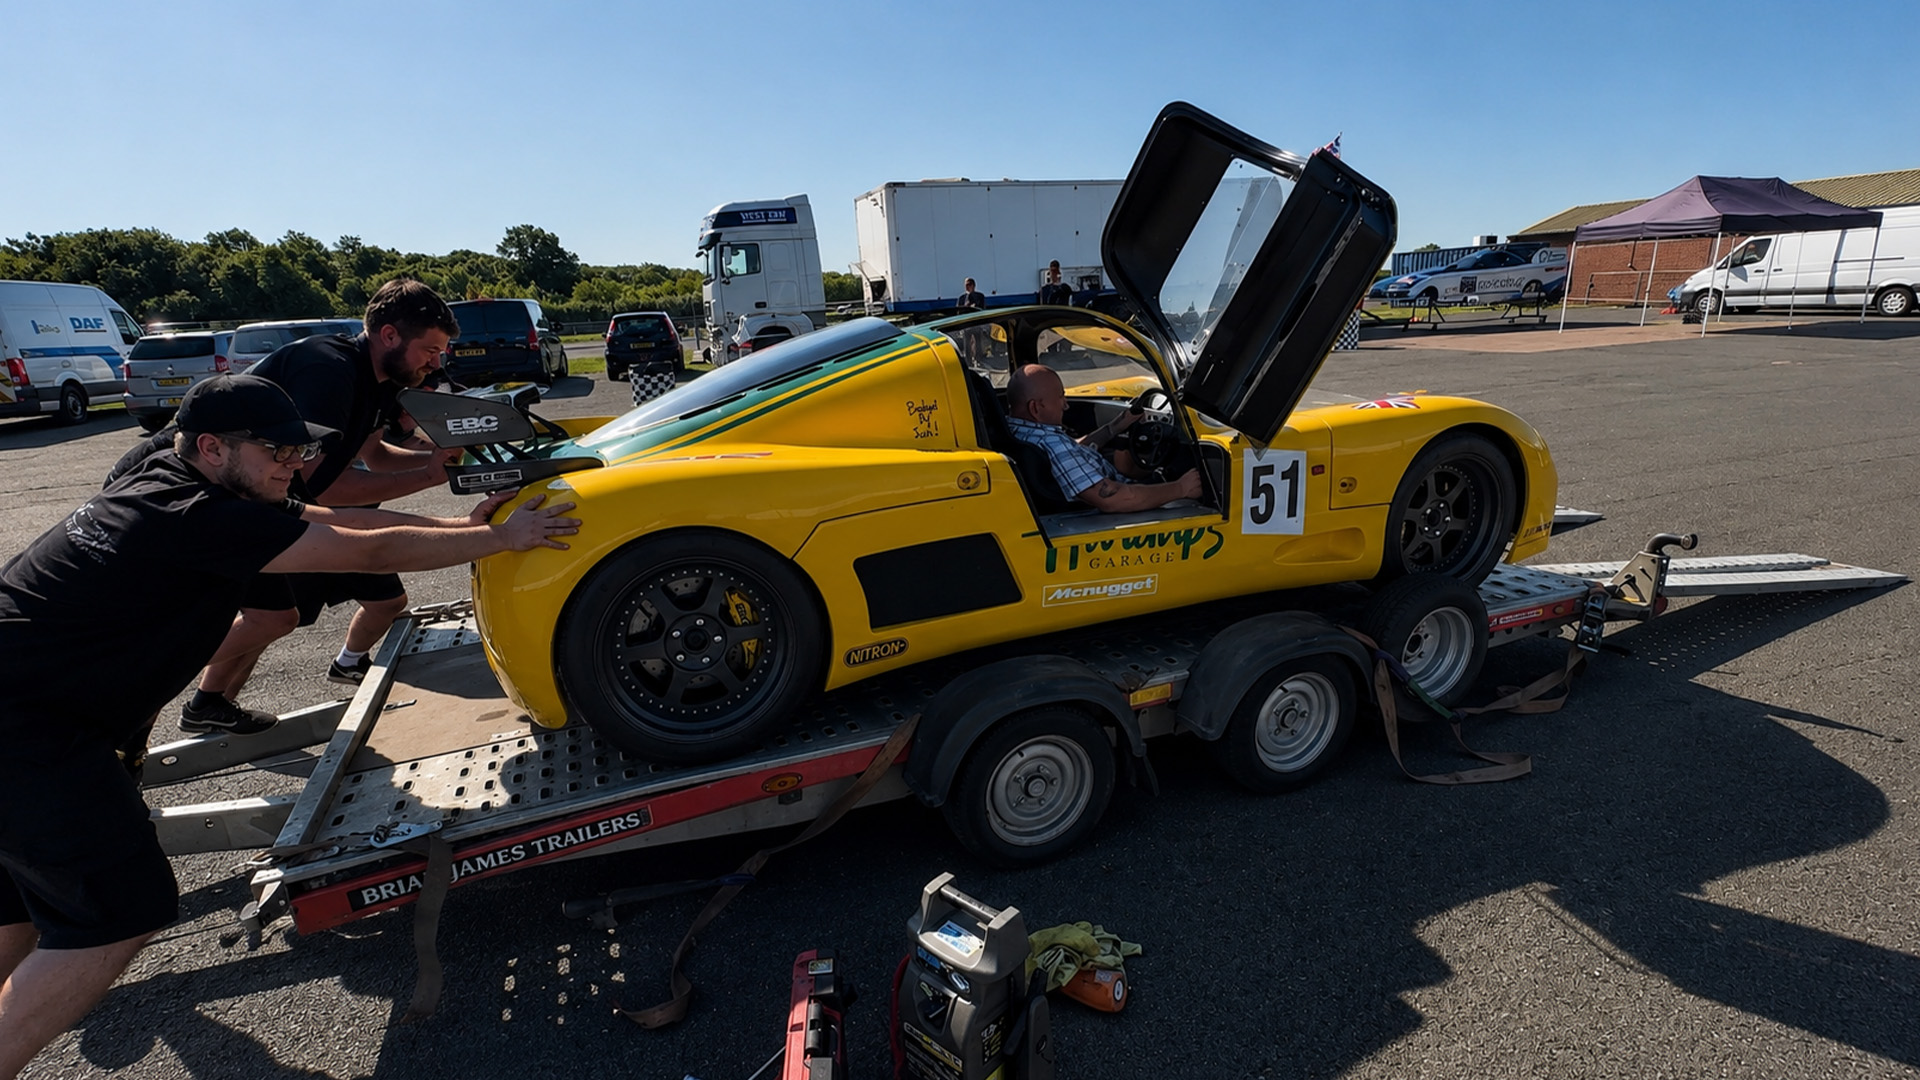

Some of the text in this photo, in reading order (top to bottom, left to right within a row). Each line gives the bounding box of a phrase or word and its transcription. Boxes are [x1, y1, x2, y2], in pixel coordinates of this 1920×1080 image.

[69, 317, 105, 329] DAF
[446, 415, 499, 431] EBC
[1250, 460, 1299, 525] 51
[1089, 552, 1175, 569] GARAGE
[1048, 577, 1154, 601] Mcnugget
[361, 873, 427, 905] BRIA
[451, 845, 526, 883] JAMES
[530, 811, 641, 854] TRAILERS
